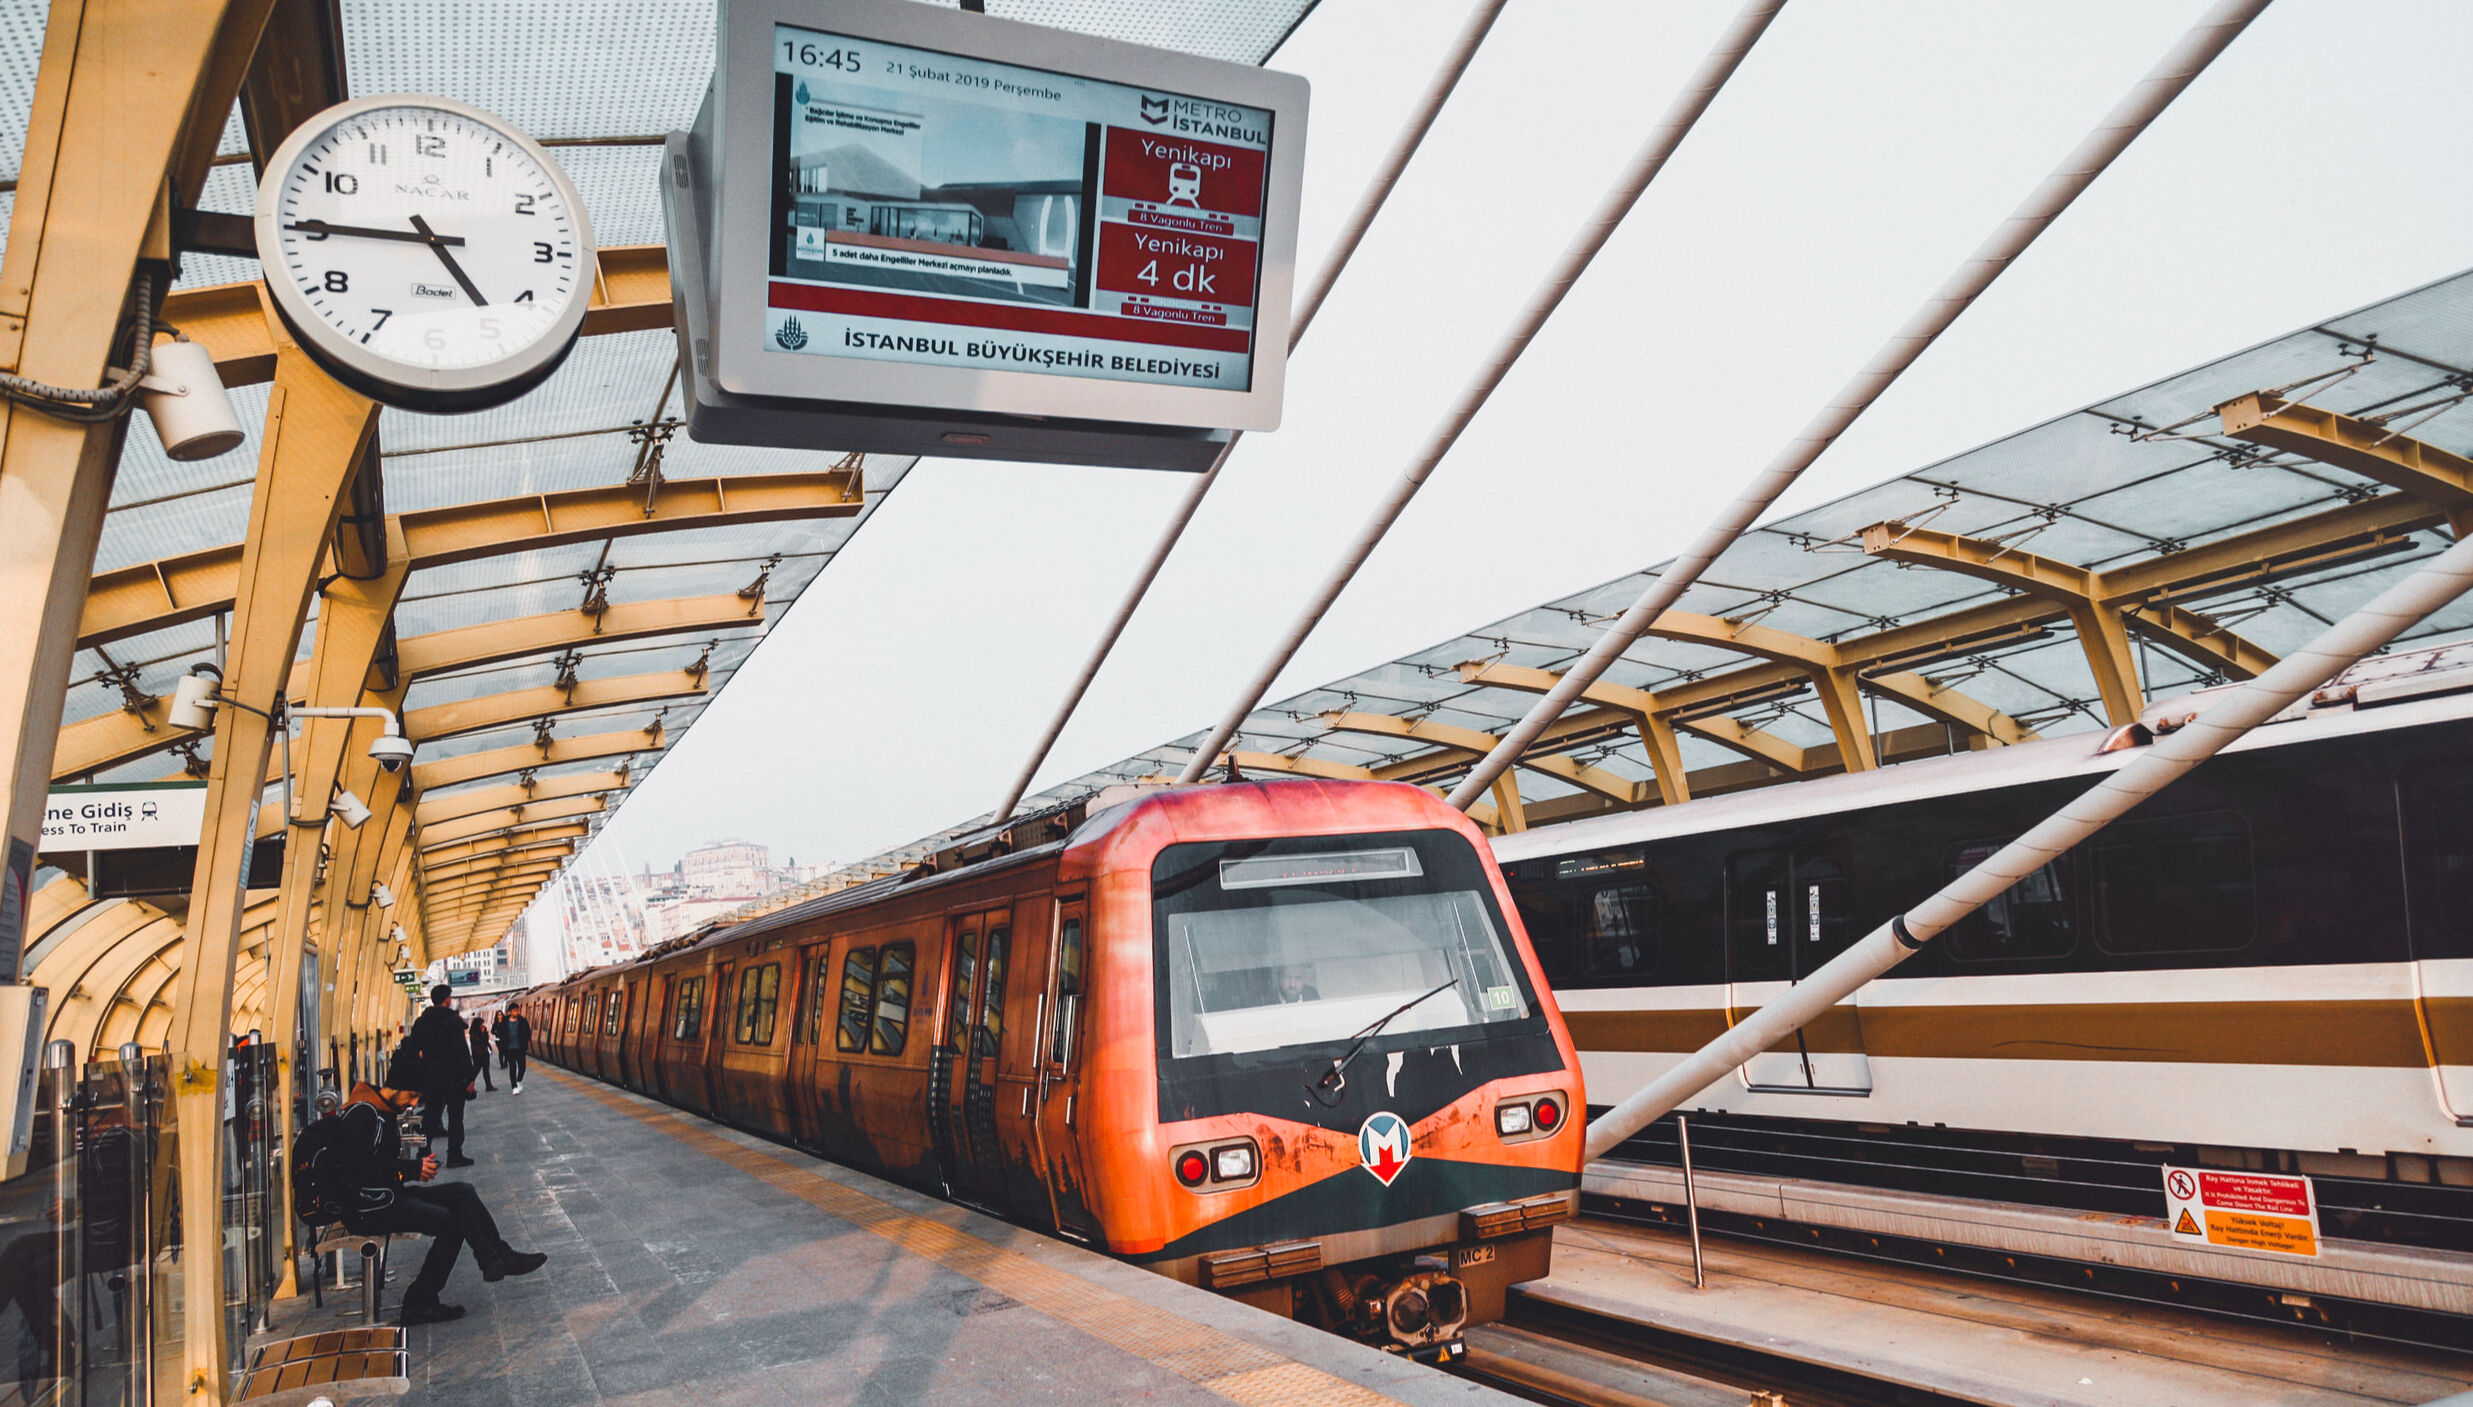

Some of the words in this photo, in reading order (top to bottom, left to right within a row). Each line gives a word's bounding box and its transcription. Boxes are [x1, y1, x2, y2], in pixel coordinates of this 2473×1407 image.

[783, 41, 861, 72] 16:45
[886, 61, 902, 74] 21
[909, 64, 950, 82] Şubat
[955, 73, 989, 88] 2019
[994, 80, 1061, 101] Perşembe
[1174, 100, 1242, 122] METRO
[1173, 118, 1267, 144] İSTANBUL
[370, 143, 386, 165] 11
[416, 134, 446, 158] 12
[1141, 138, 1232, 169] Yenikapı
[325, 171, 359, 195] 10
[396, 184, 470, 201] NACAR
[515, 193, 536, 215] 2
[1140, 213, 1147, 221] 8
[1150, 214, 1196, 228] Vagonlu
[1200, 219, 1222, 232] Tren
[534, 241, 554, 264] 3
[1135, 232, 1224, 262] Yenikapı
[832, 248, 838, 257] 5
[839, 250, 857, 259] adet
[859, 252, 879, 261] daha
[880, 254, 916, 265] Engelliler
[918, 258, 948, 267] Merkezi
[949, 263, 976, 272] açmayı
[324, 271, 348, 294] 8
[1136, 260, 1159, 287] 4
[1173, 263, 1216, 294] dk
[416, 284, 453, 298] Bodet
[514, 290, 537, 311] 4
[371, 308, 392, 331] 7
[1133, 306, 1140, 314] 8
[1143, 306, 1188, 320] Vagonlu
[1193, 312, 1215, 322] Tren
[424, 328, 446, 351] 6
[480, 318, 501, 340] 5
[845, 328, 958, 356] İSTANBUL
[966, 340, 1104, 368] BÜYÜKŞEHİR
[1111, 356, 1220, 379] BELEDİYESİ
[43, 808, 73, 820] ne
[81, 802, 132, 821] Gidiş
[69, 824, 85, 834] To
[90, 821, 126, 833] Train
[1494, 990, 1510, 1004] 10
[1460, 1248, 1480, 1265] MC
[1486, 1246, 1494, 1259] 2
